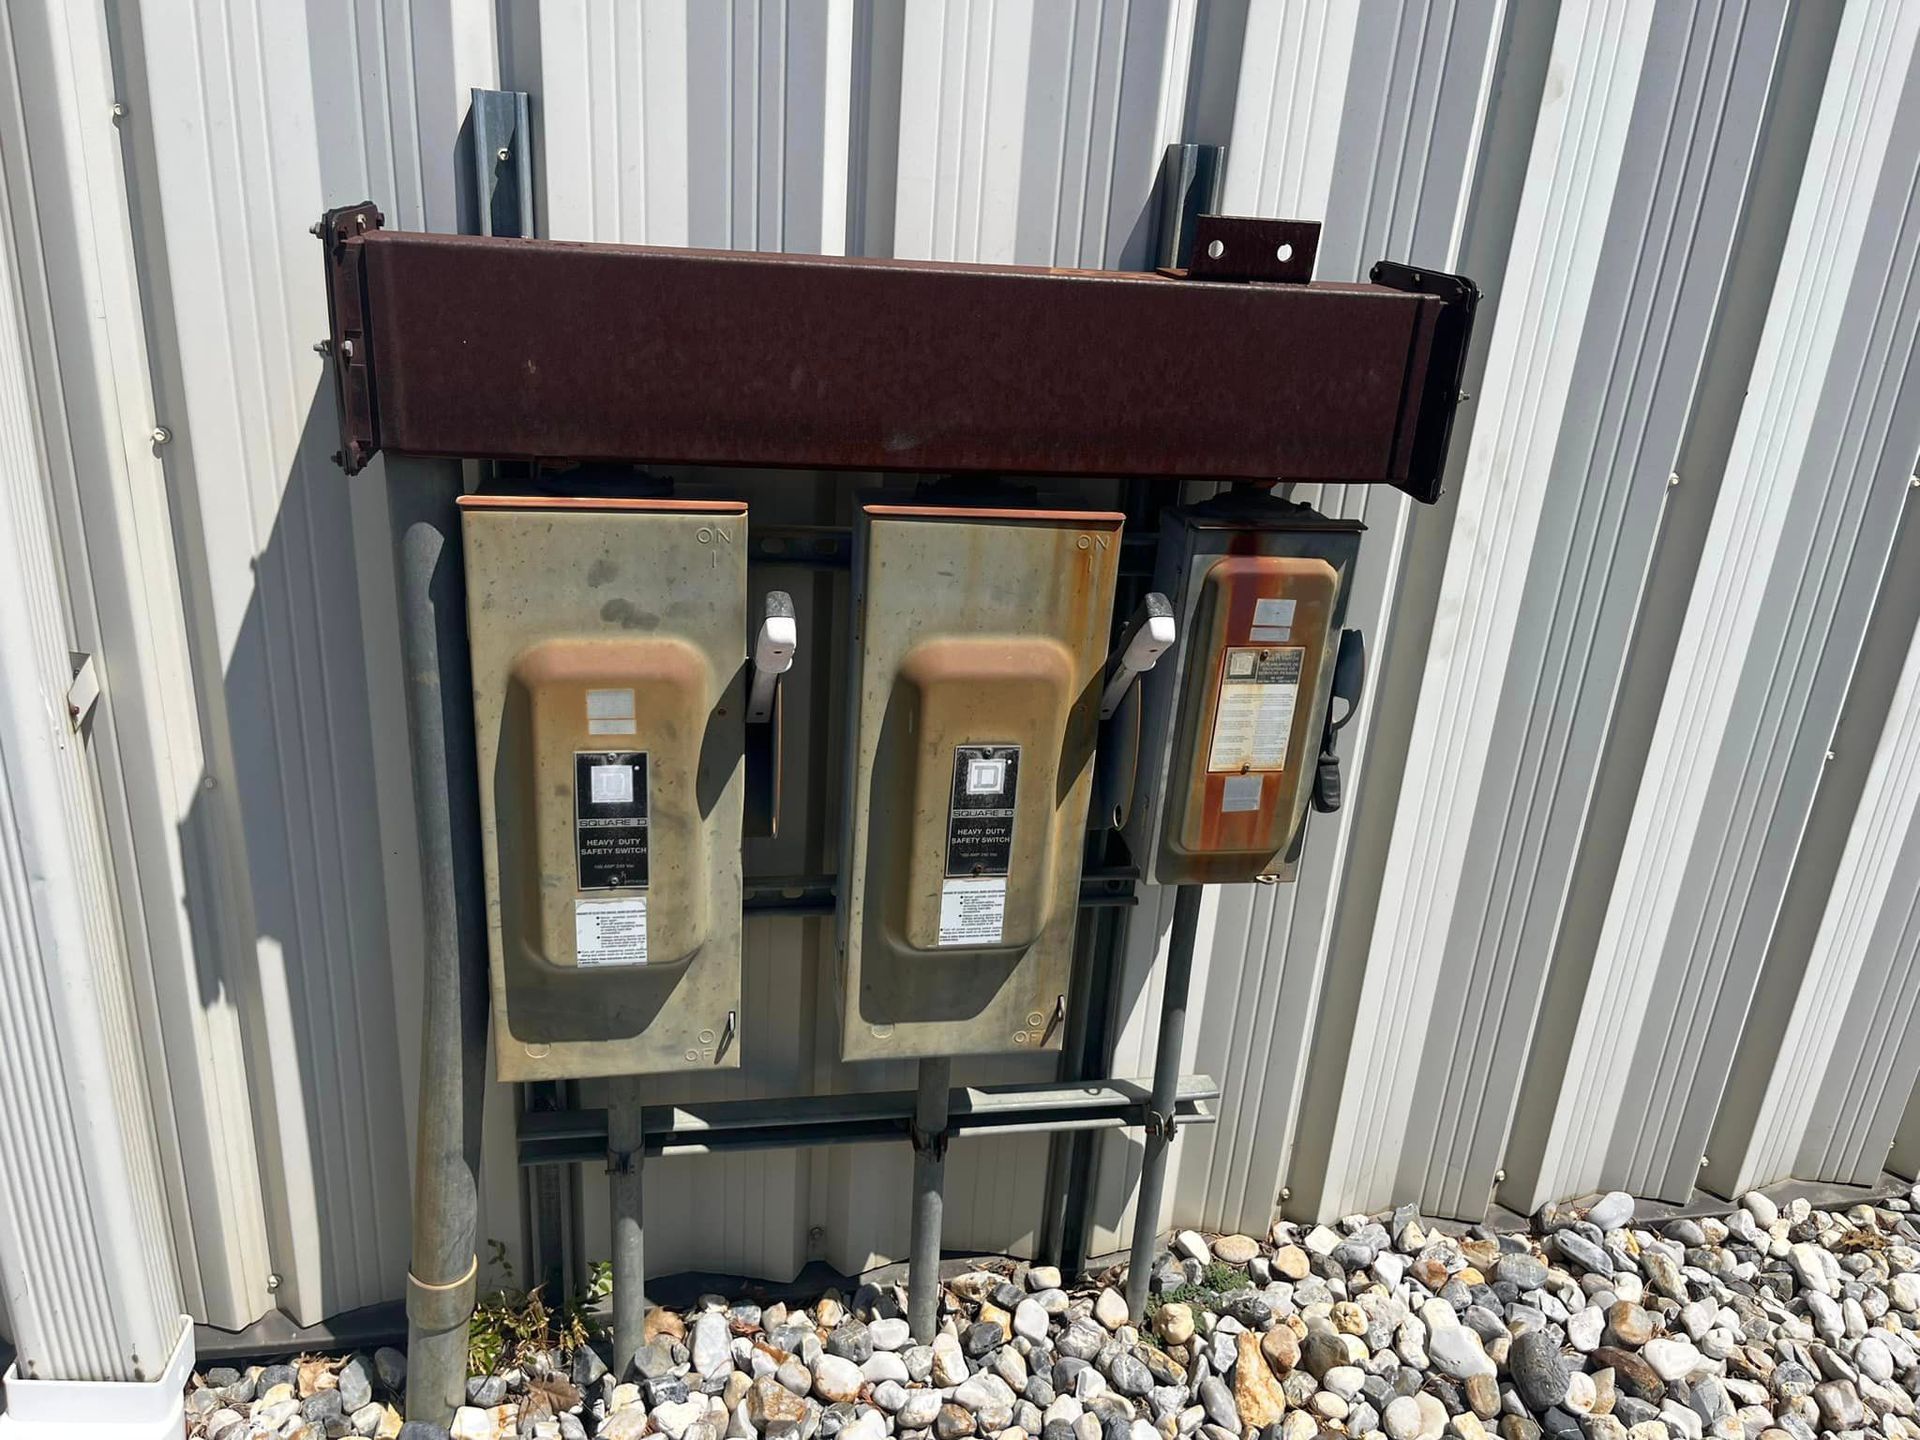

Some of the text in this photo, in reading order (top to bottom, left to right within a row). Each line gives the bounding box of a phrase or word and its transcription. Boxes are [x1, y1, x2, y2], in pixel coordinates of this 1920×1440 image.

[696, 527, 732, 544] ON
[1076, 534, 1110, 551] ON
[953, 809, 999, 817] SQUARE
[579, 818, 647, 827] SQUARE D
